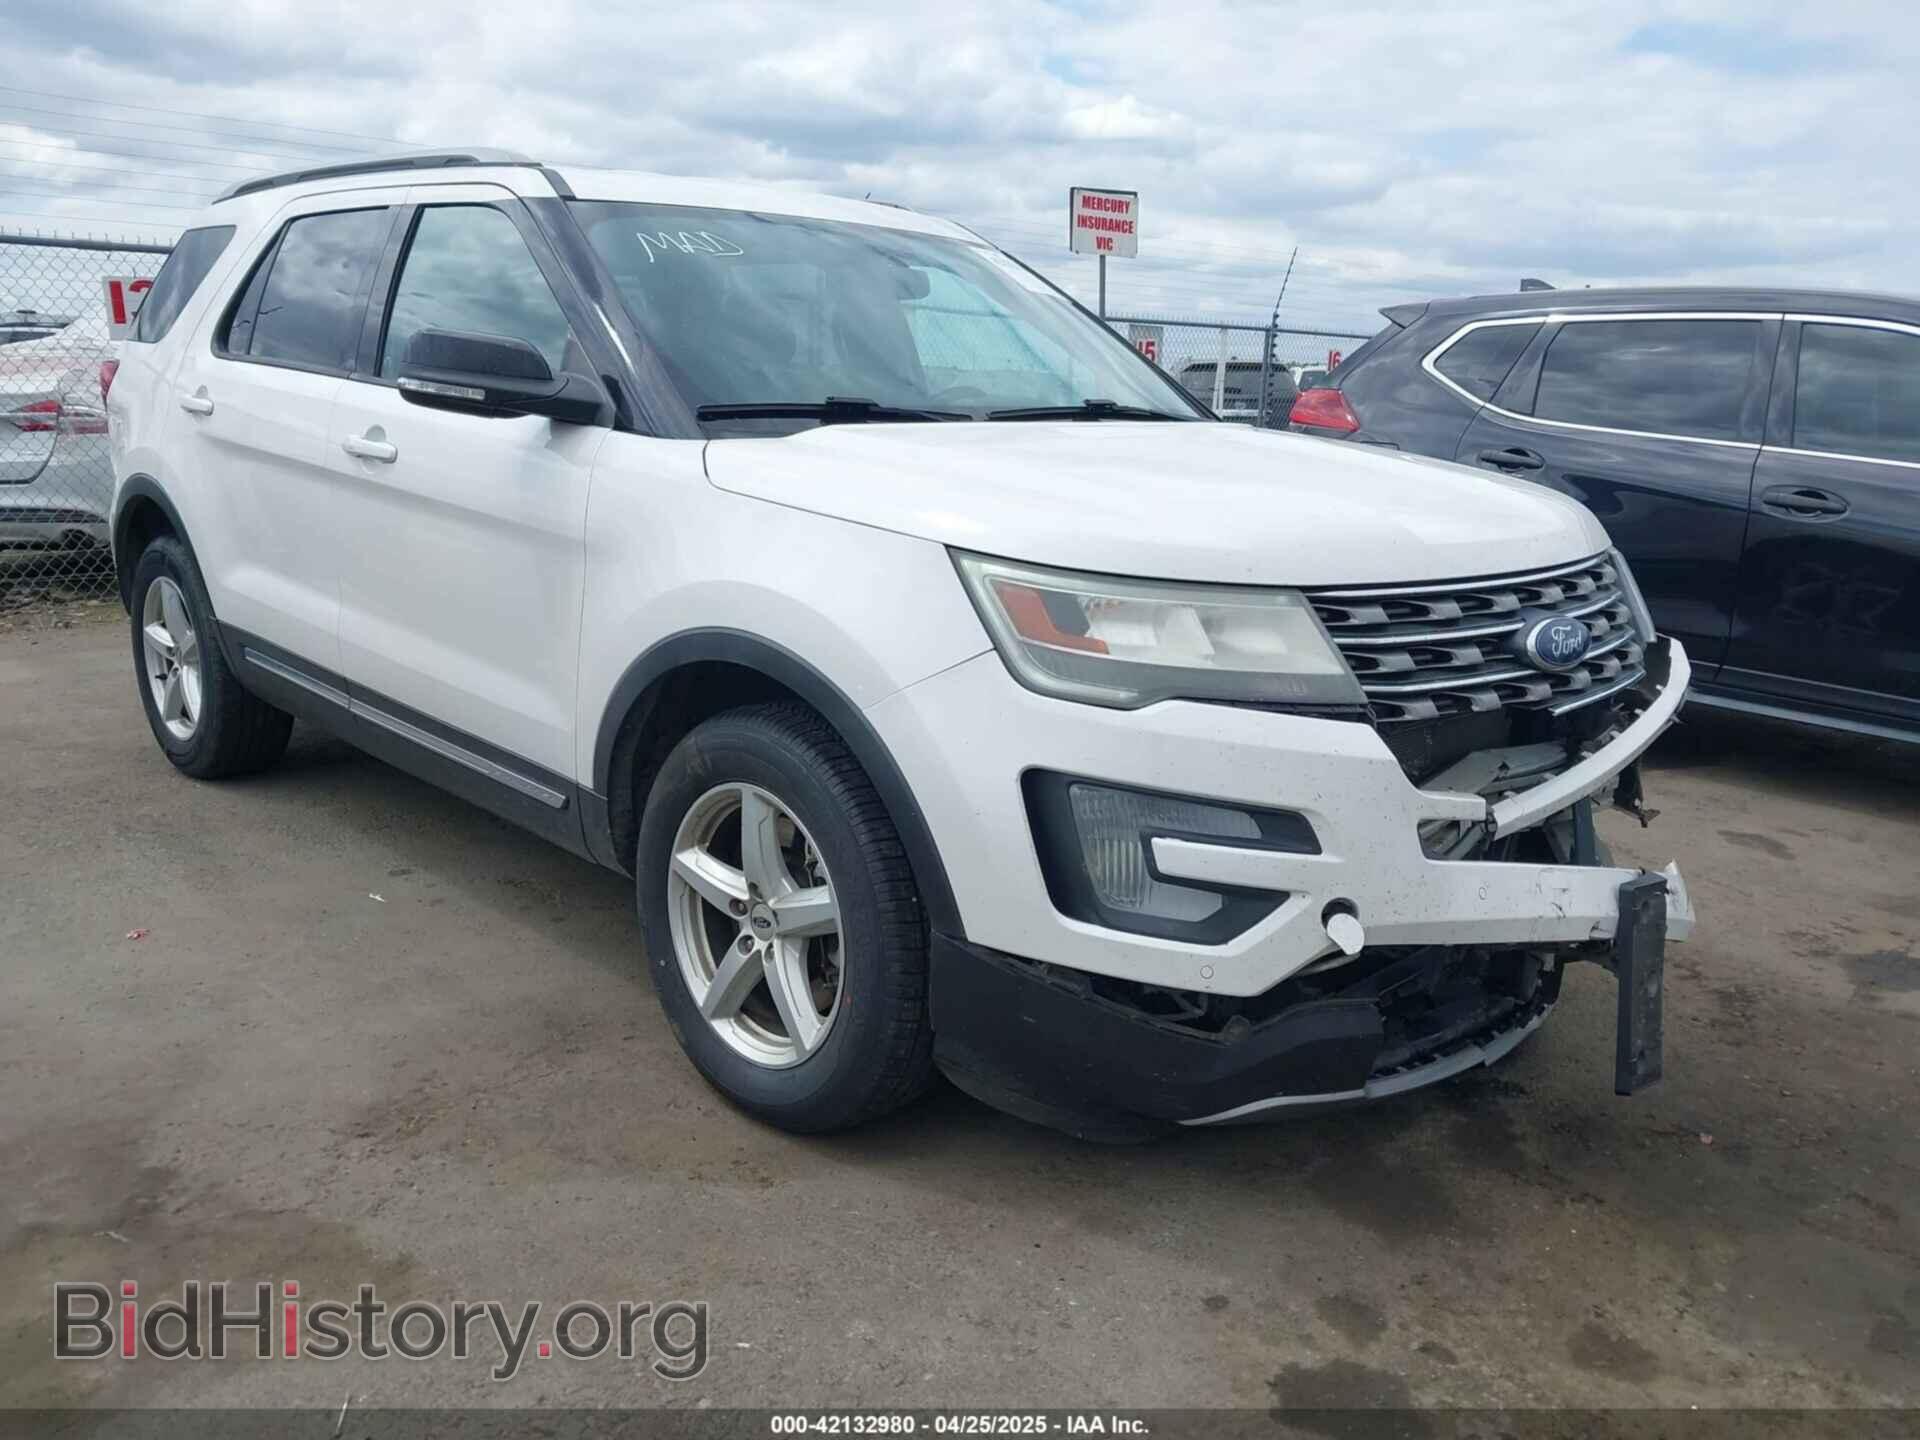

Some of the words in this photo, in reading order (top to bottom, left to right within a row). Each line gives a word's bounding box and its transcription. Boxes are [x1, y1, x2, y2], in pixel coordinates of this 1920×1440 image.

[1082, 195, 1130, 214] MERCURY
[1077, 214, 1134, 234] INSURANCE
[636, 231, 744, 263] MAD
[1096, 236, 1113, 251] VIC
[1551, 625, 1582, 657] Ford
